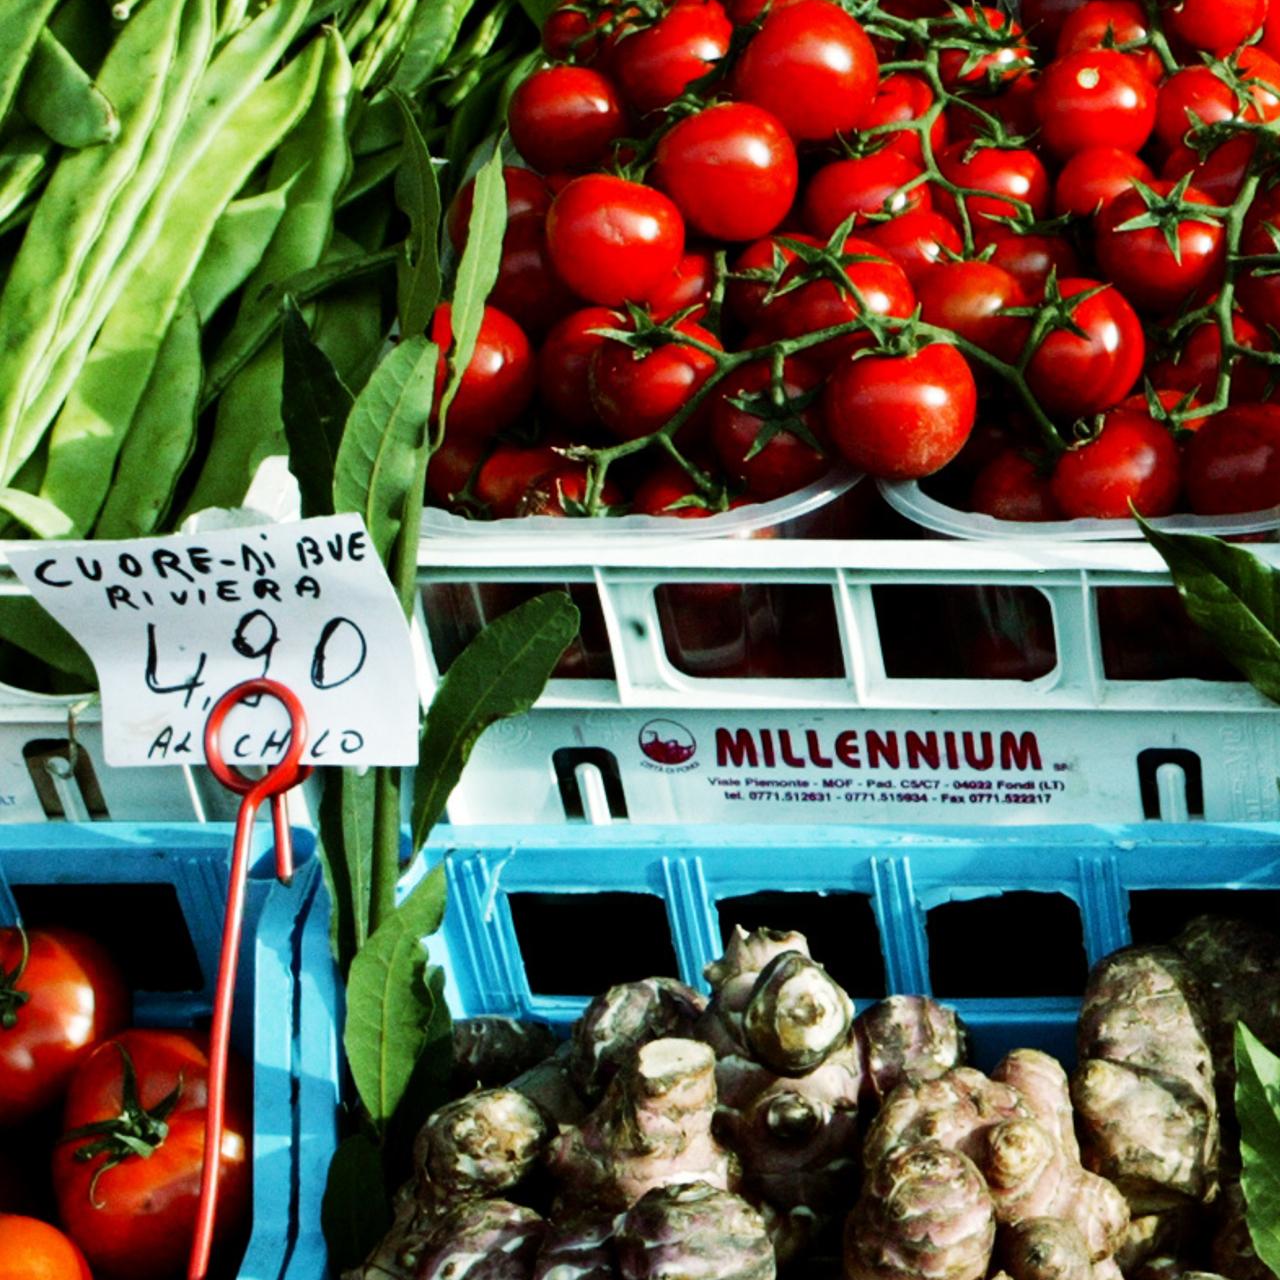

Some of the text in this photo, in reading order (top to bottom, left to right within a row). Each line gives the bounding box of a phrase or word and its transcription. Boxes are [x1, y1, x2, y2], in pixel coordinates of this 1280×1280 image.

[714, 727, 1043, 771] MILLENNIUM
[708, 777, 741, 787] Viale
[745, 778, 809, 789] Piemonte
[822, 780, 853, 789] MOF
[996, 780, 1035, 791] Fondi
[1038, 781, 1065, 792] (LT)
[941, 794, 964, 804] Fax
